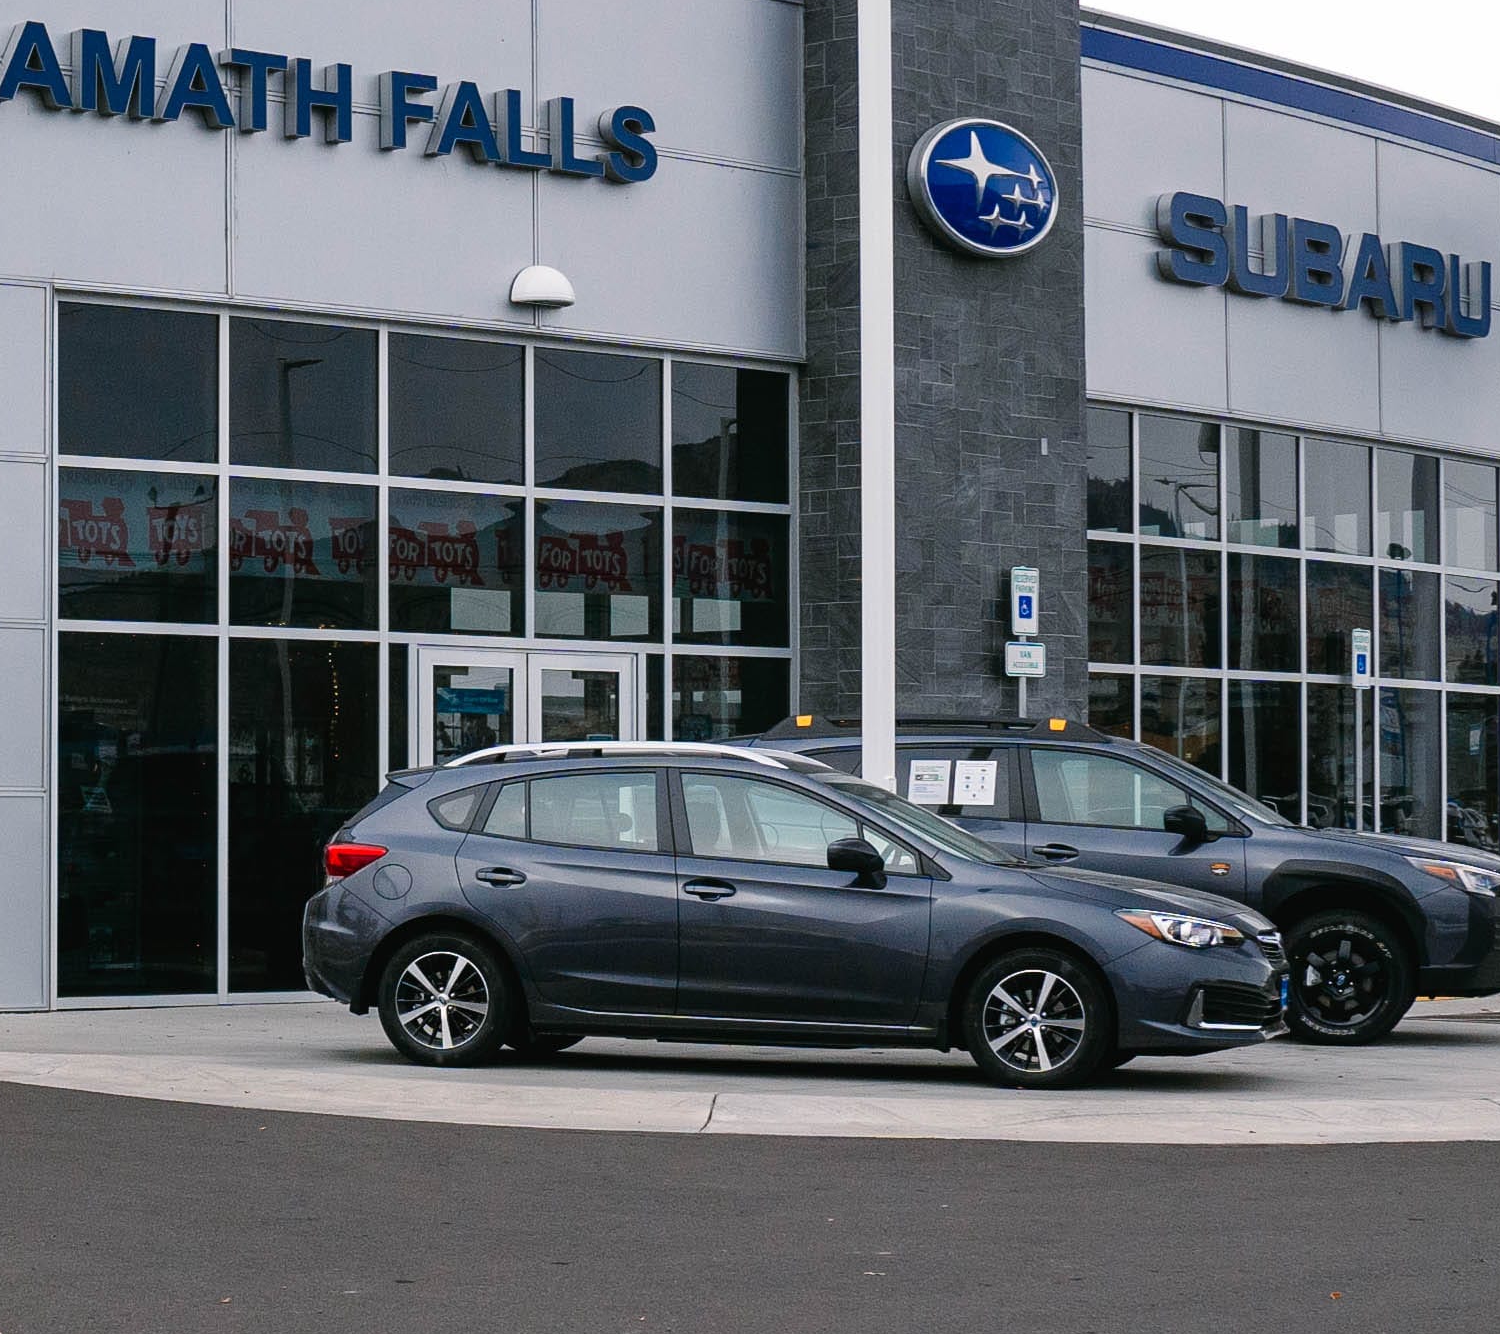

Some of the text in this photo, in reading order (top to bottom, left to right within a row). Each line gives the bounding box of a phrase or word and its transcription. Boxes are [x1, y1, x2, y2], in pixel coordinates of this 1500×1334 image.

[378, 70, 659, 185] FALLS
[1155, 191, 1491, 338] SUBARU
[71, 519, 121, 549] TOTS
[257, 530, 307, 558] TOTS
[389, 535, 420, 563] FOR
[430, 541, 473, 570] TOTS
[540, 542, 571, 570] FOR
[582, 547, 621, 576] TOTS
